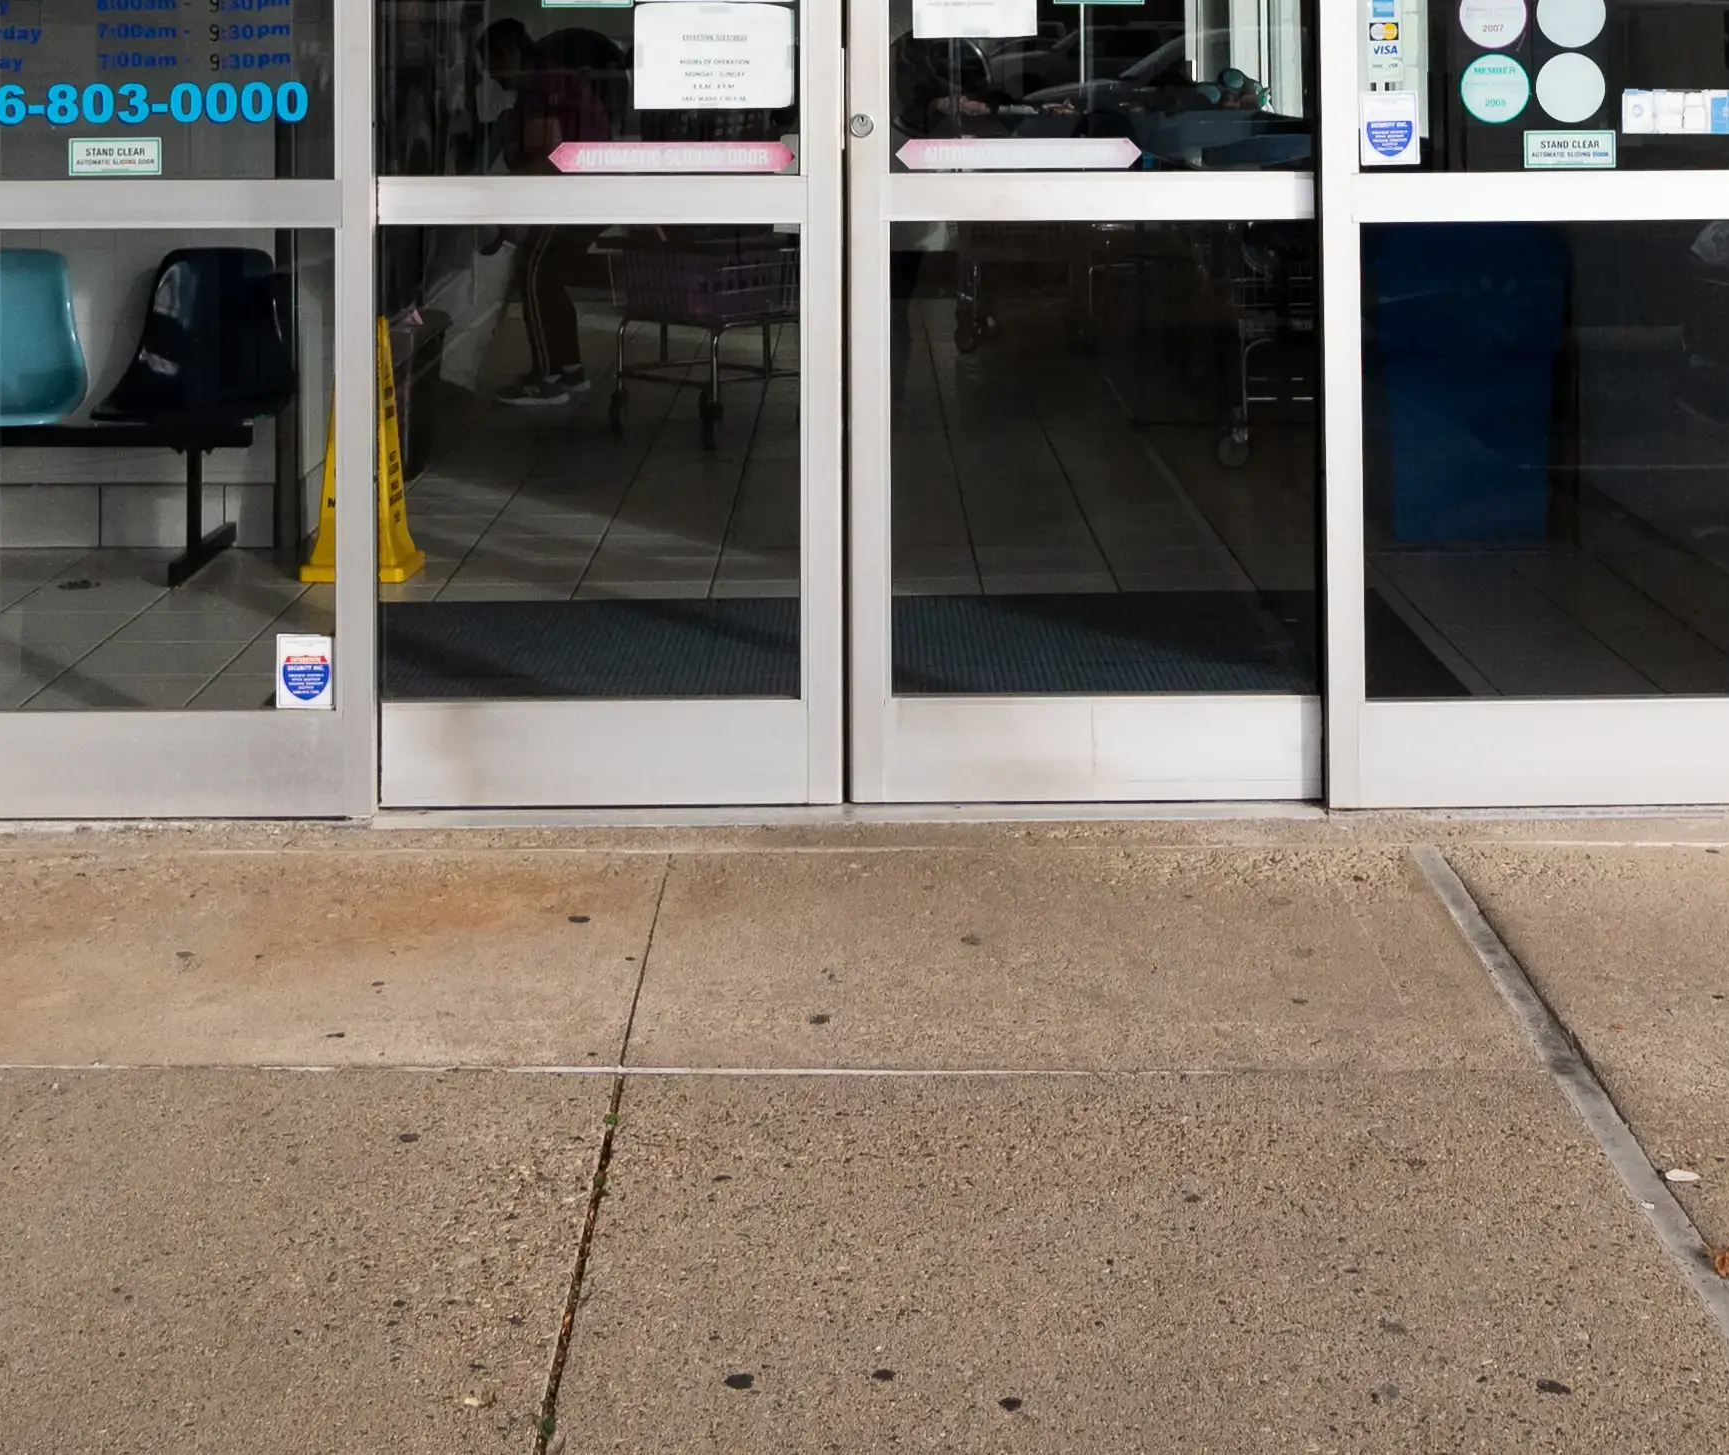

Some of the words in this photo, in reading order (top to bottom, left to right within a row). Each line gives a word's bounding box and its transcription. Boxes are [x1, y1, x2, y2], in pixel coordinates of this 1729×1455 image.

[1482, 24, 1505, 33] 2007
[1373, 45, 1398, 55] VISA
[1473, 66, 1516, 75] MEMBER
[1540, 139, 1569, 149] STAND
[1571, 139, 1600, 149] CLEAR
[85, 147, 114, 156] STAND
[117, 147, 146, 156] CLEAR
[576, 148, 661, 165] AUTOMATIC
[728, 148, 768, 165] DOOR
